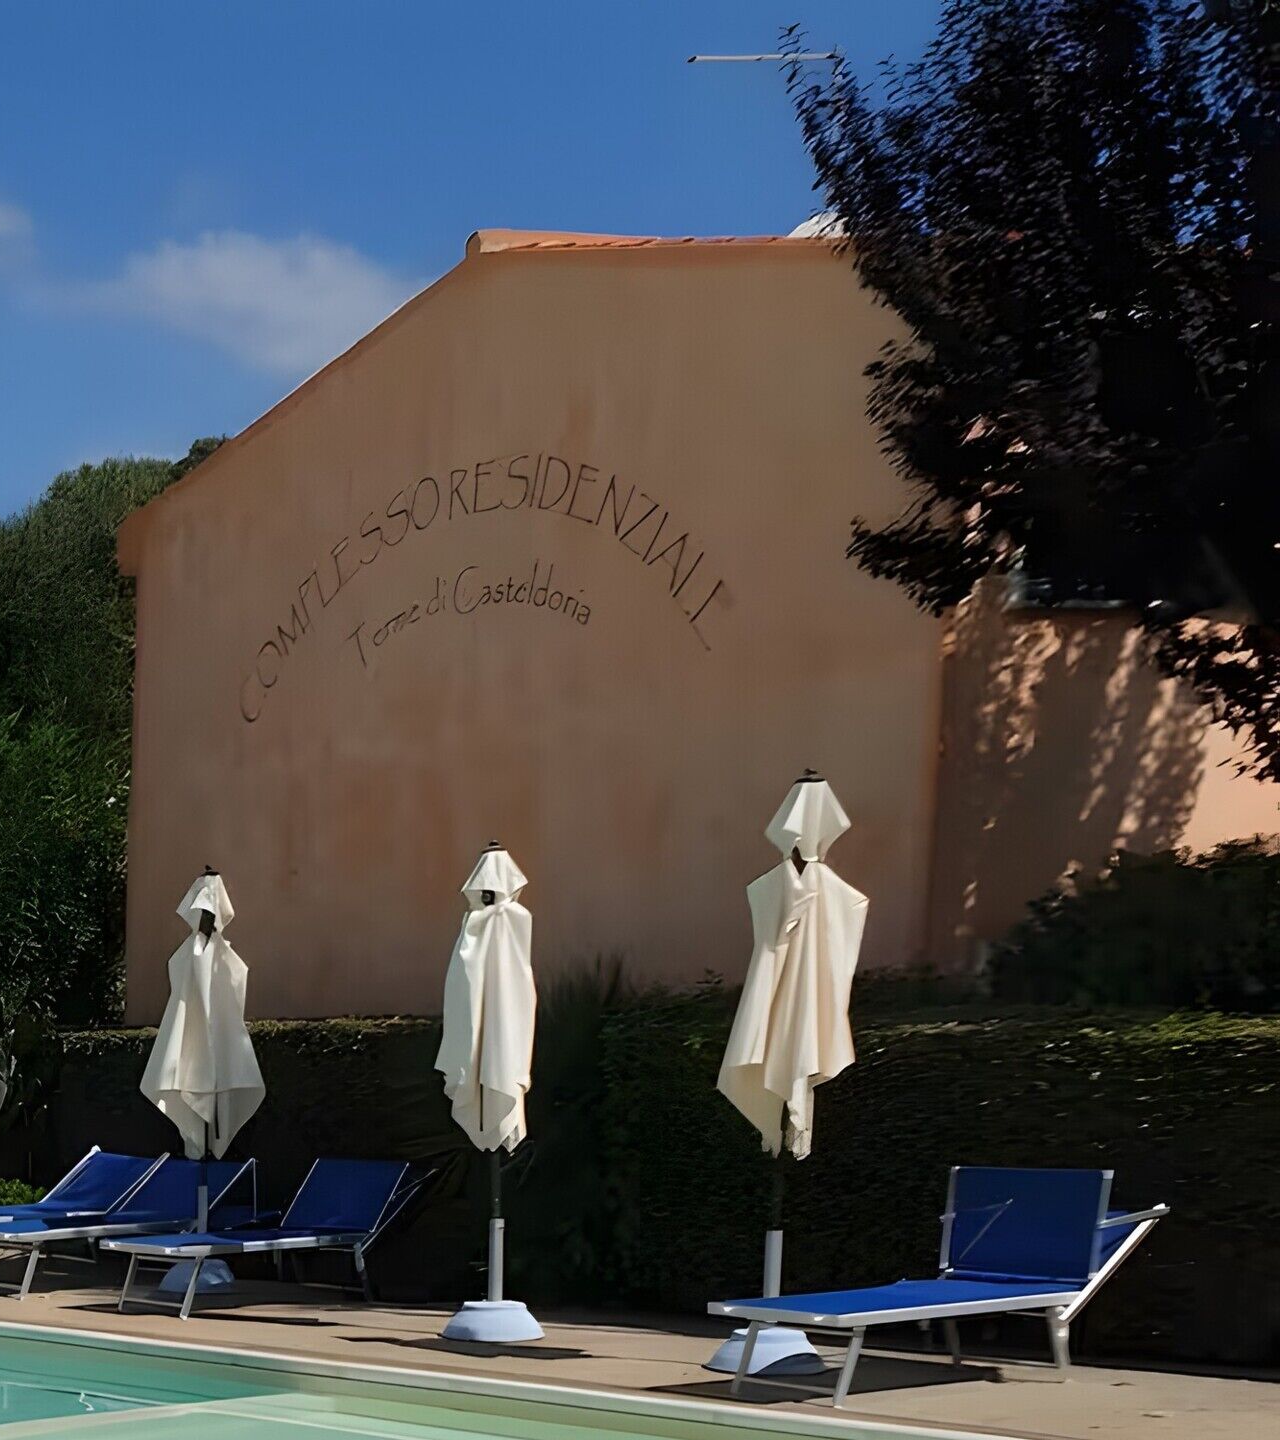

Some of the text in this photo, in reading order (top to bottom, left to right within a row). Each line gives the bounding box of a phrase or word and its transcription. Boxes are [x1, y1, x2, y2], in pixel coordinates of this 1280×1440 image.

[426, 577, 446, 615] di
[453, 558, 591, 625] Casteldoria
[448, 452, 728, 651] RESIDENZIALE
